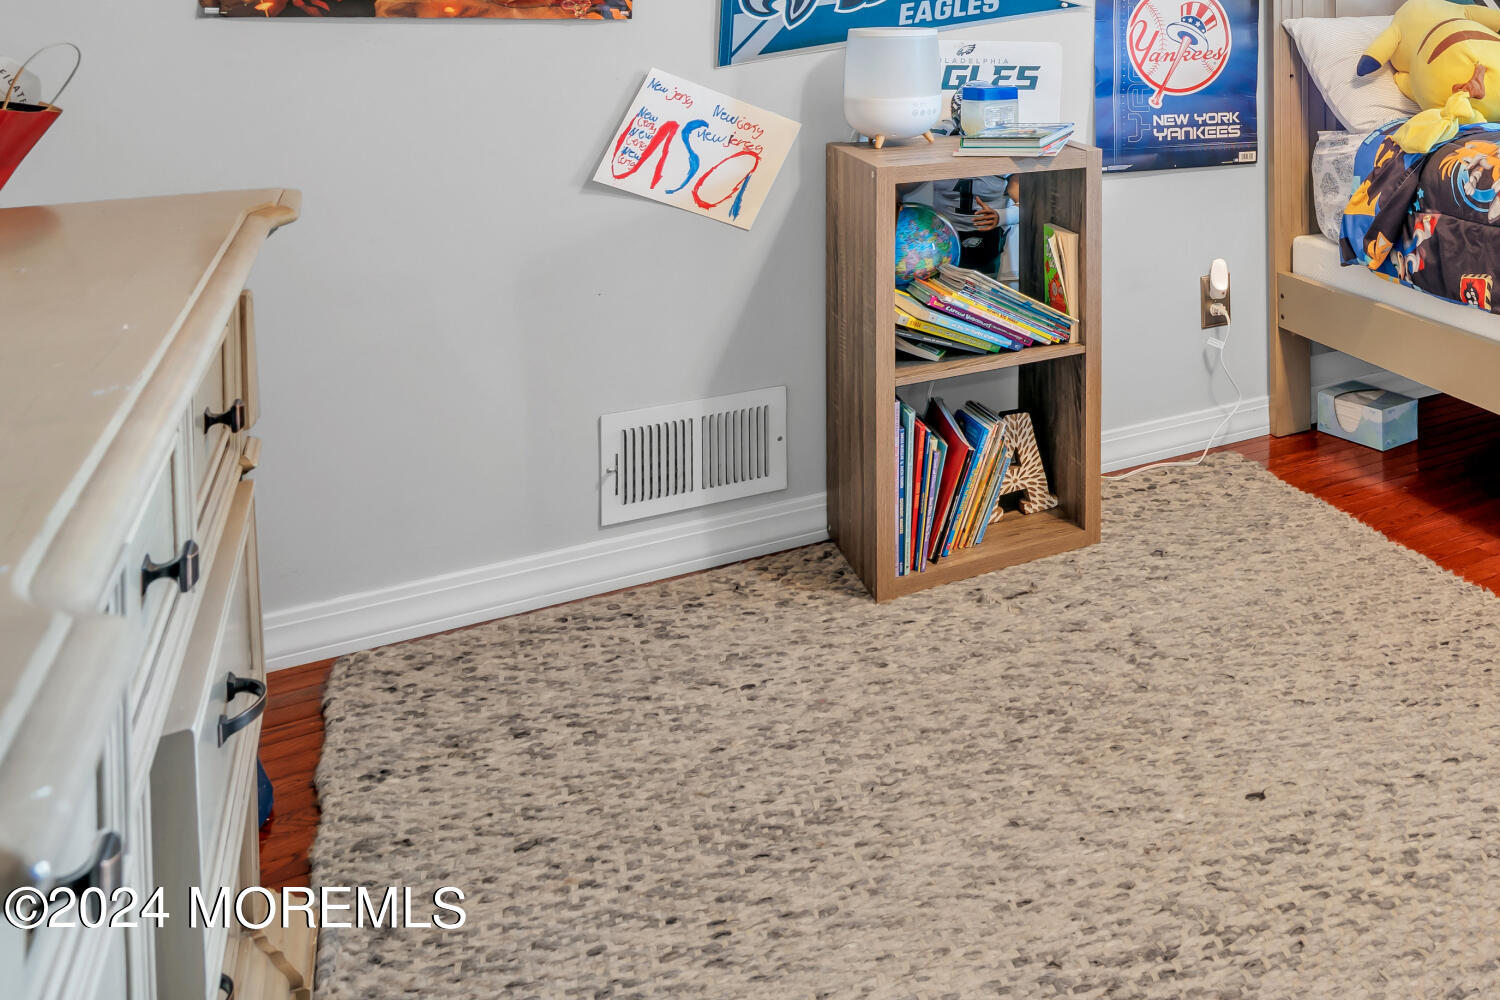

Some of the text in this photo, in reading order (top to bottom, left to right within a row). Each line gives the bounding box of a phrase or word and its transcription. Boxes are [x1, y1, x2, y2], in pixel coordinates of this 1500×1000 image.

[1130, 20, 1228, 68] Yankees
[940, 57, 1009, 65] ILADELPHIA
[941, 64, 1041, 90] GLES
[1152, 111, 1241, 127] NEW YORK
[1153, 125, 1241, 141] YANKEES
